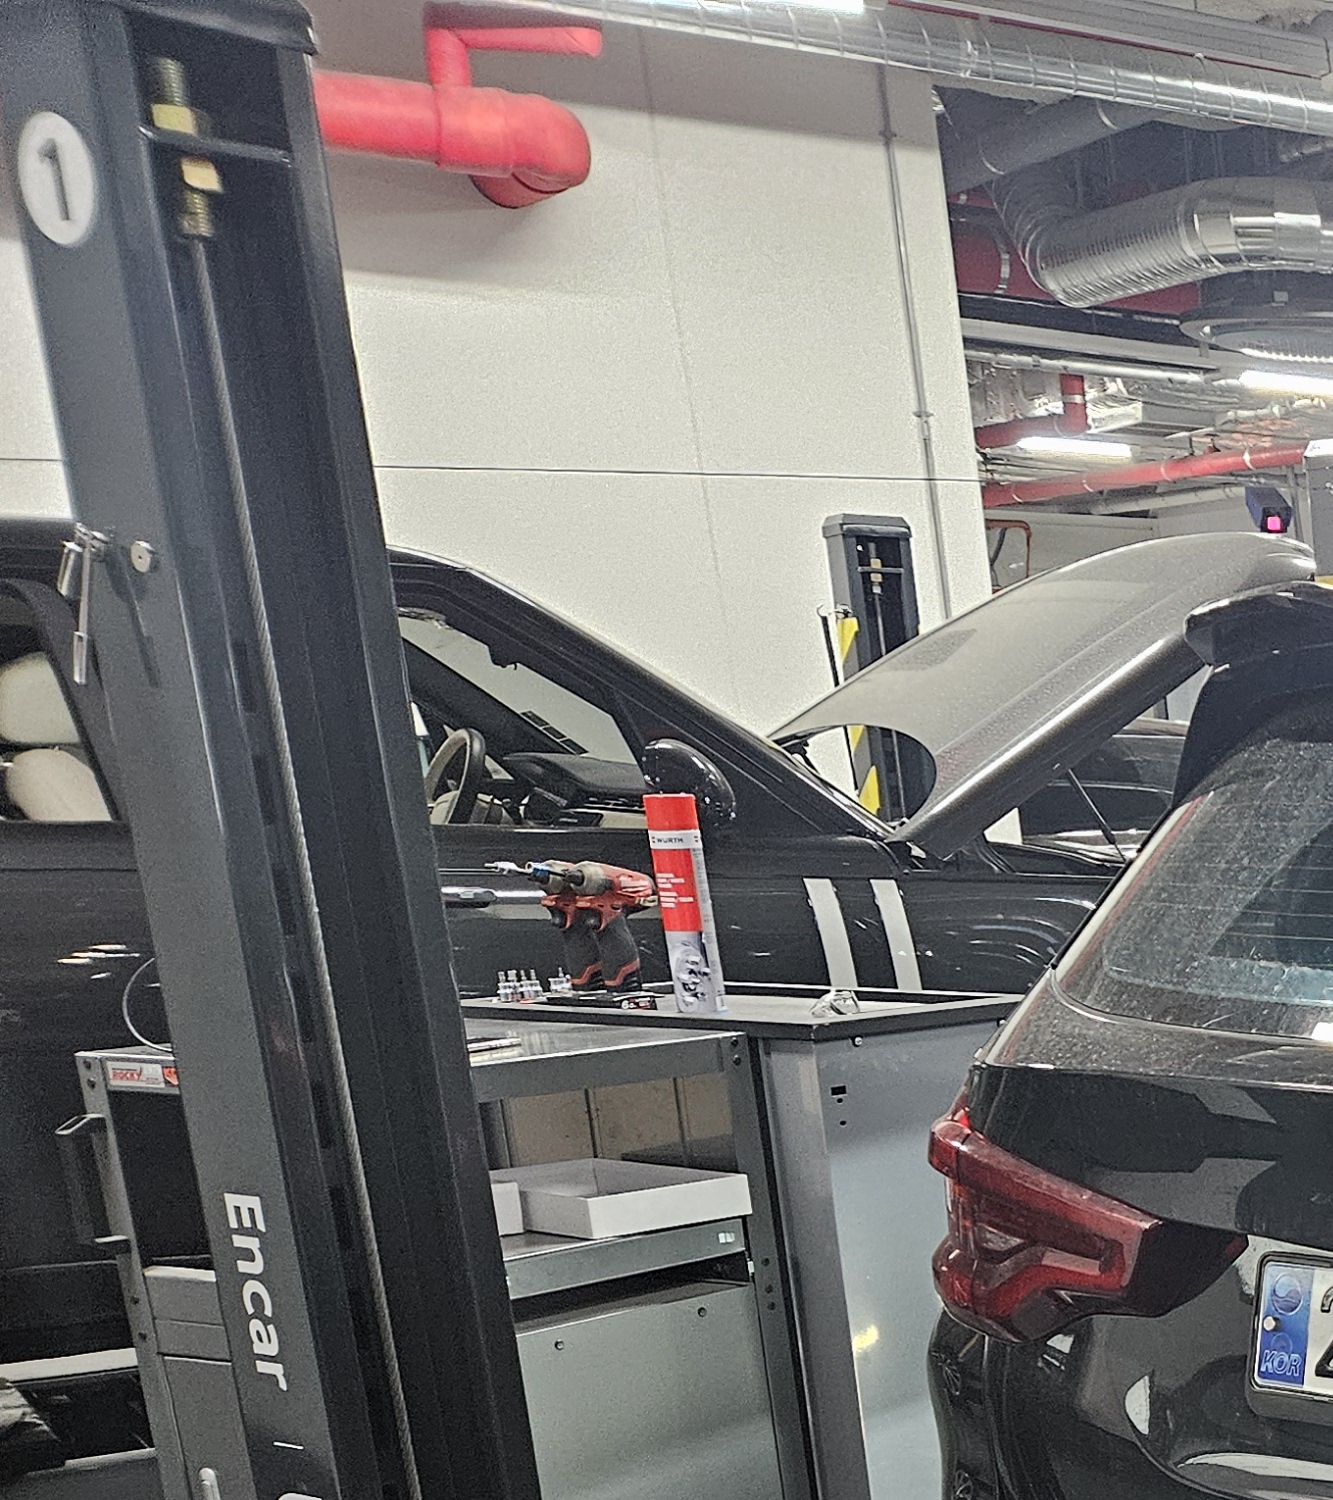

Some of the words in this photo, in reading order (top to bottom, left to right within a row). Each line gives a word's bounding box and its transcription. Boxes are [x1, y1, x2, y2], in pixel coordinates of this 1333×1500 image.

[39, 139, 70, 221] 1
[223, 1193, 288, 1391] Encar
[1261, 1347, 1302, 1378] KOR
